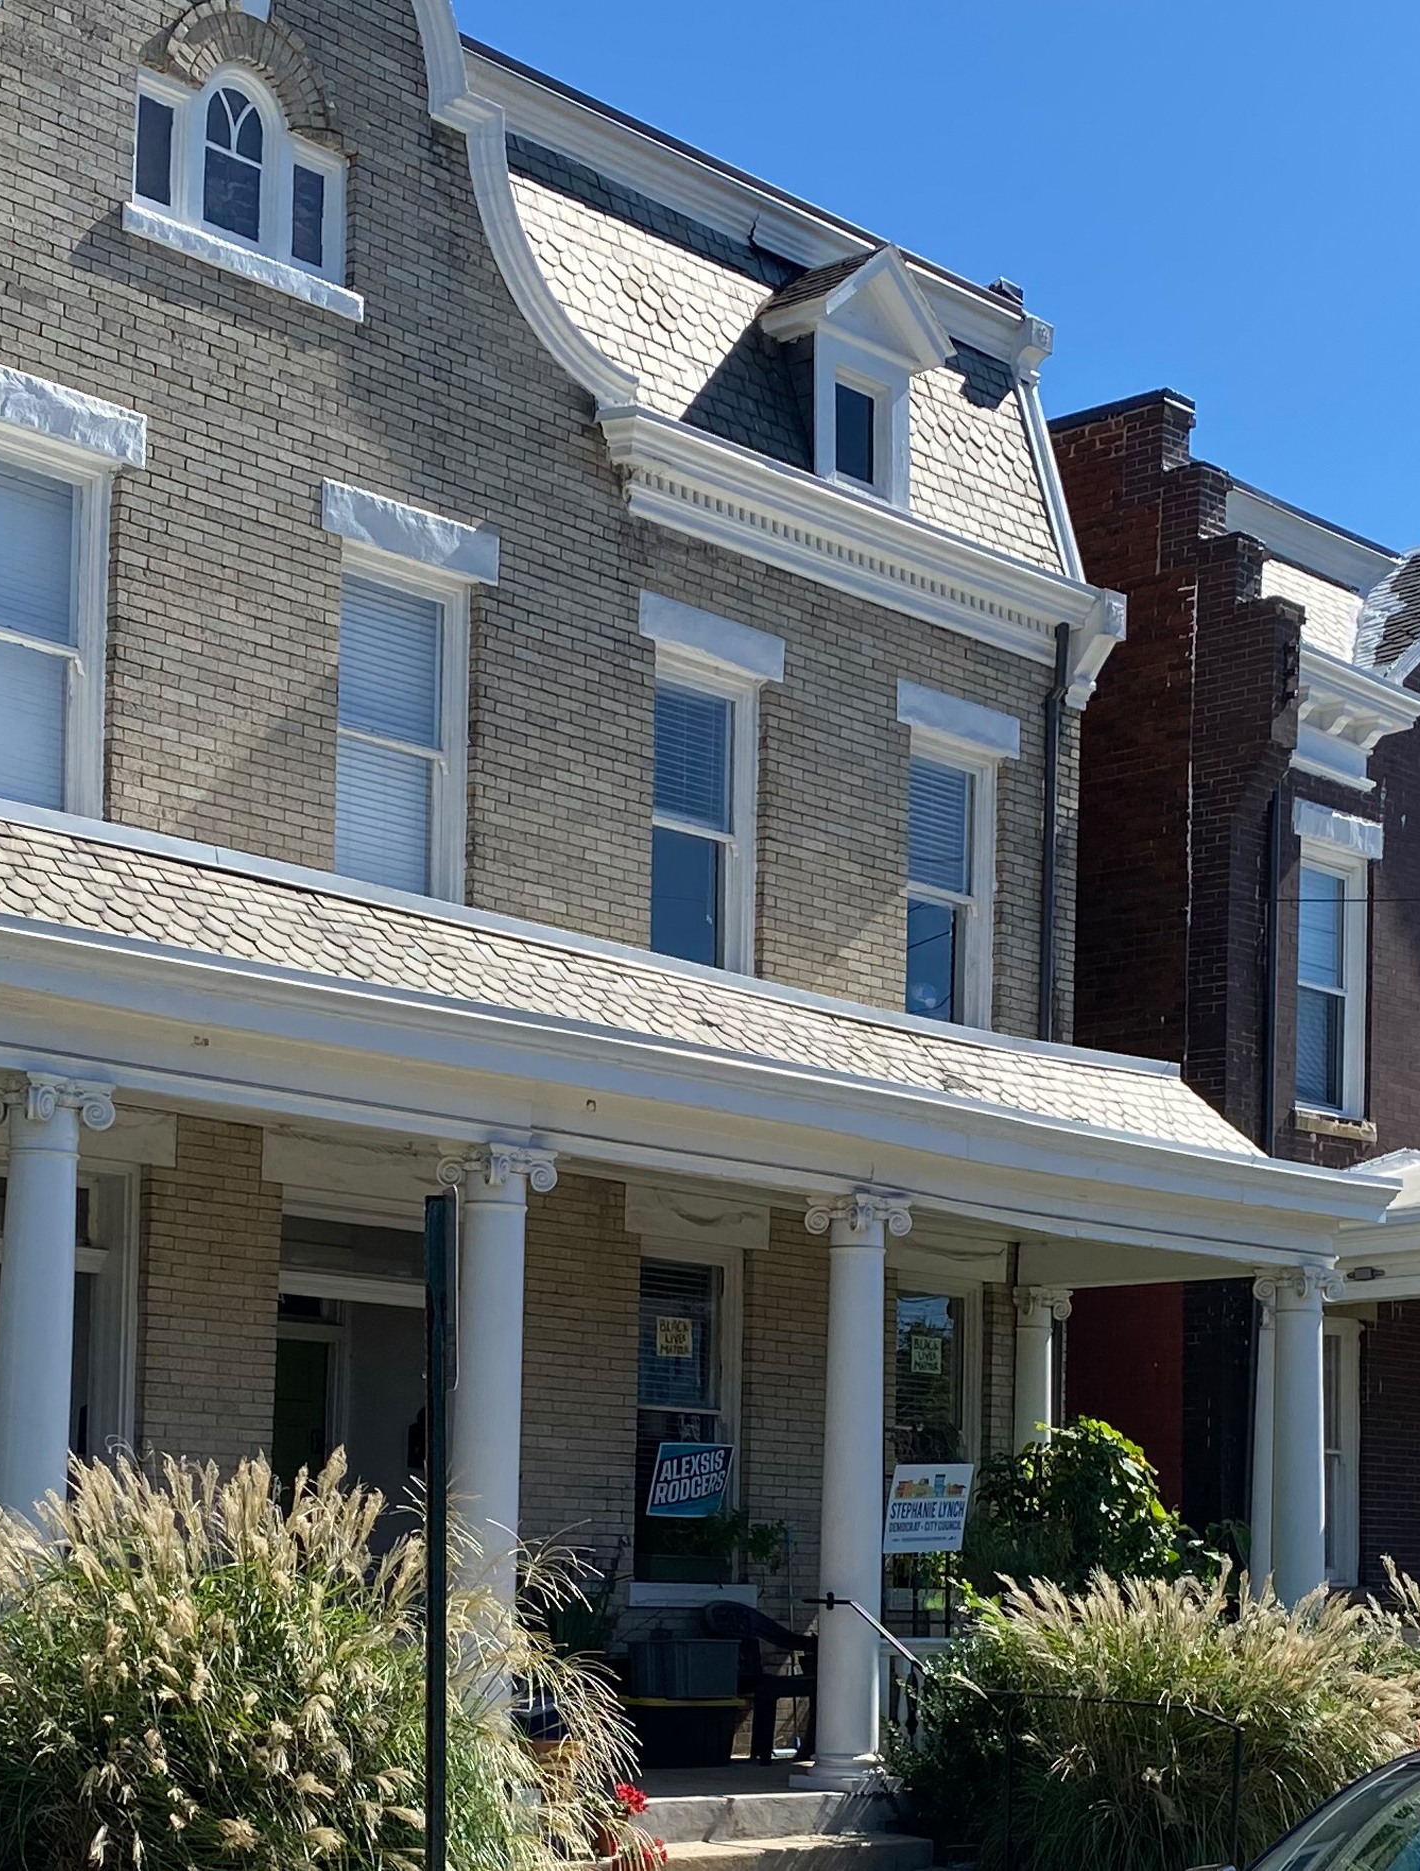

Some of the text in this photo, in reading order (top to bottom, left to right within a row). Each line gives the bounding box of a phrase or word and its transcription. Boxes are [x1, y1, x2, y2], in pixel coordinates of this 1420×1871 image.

[660, 1318, 689, 1333] BLACK
[914, 1338, 939, 1351] BLACK
[659, 1449, 725, 1482] ALEXSIS
[653, 1470, 726, 1505] RODGERS
[890, 1500, 966, 1519] STEPHANIE LYNCH
[889, 1520, 962, 1533] DEMOCRAT CITY COUNCIL
